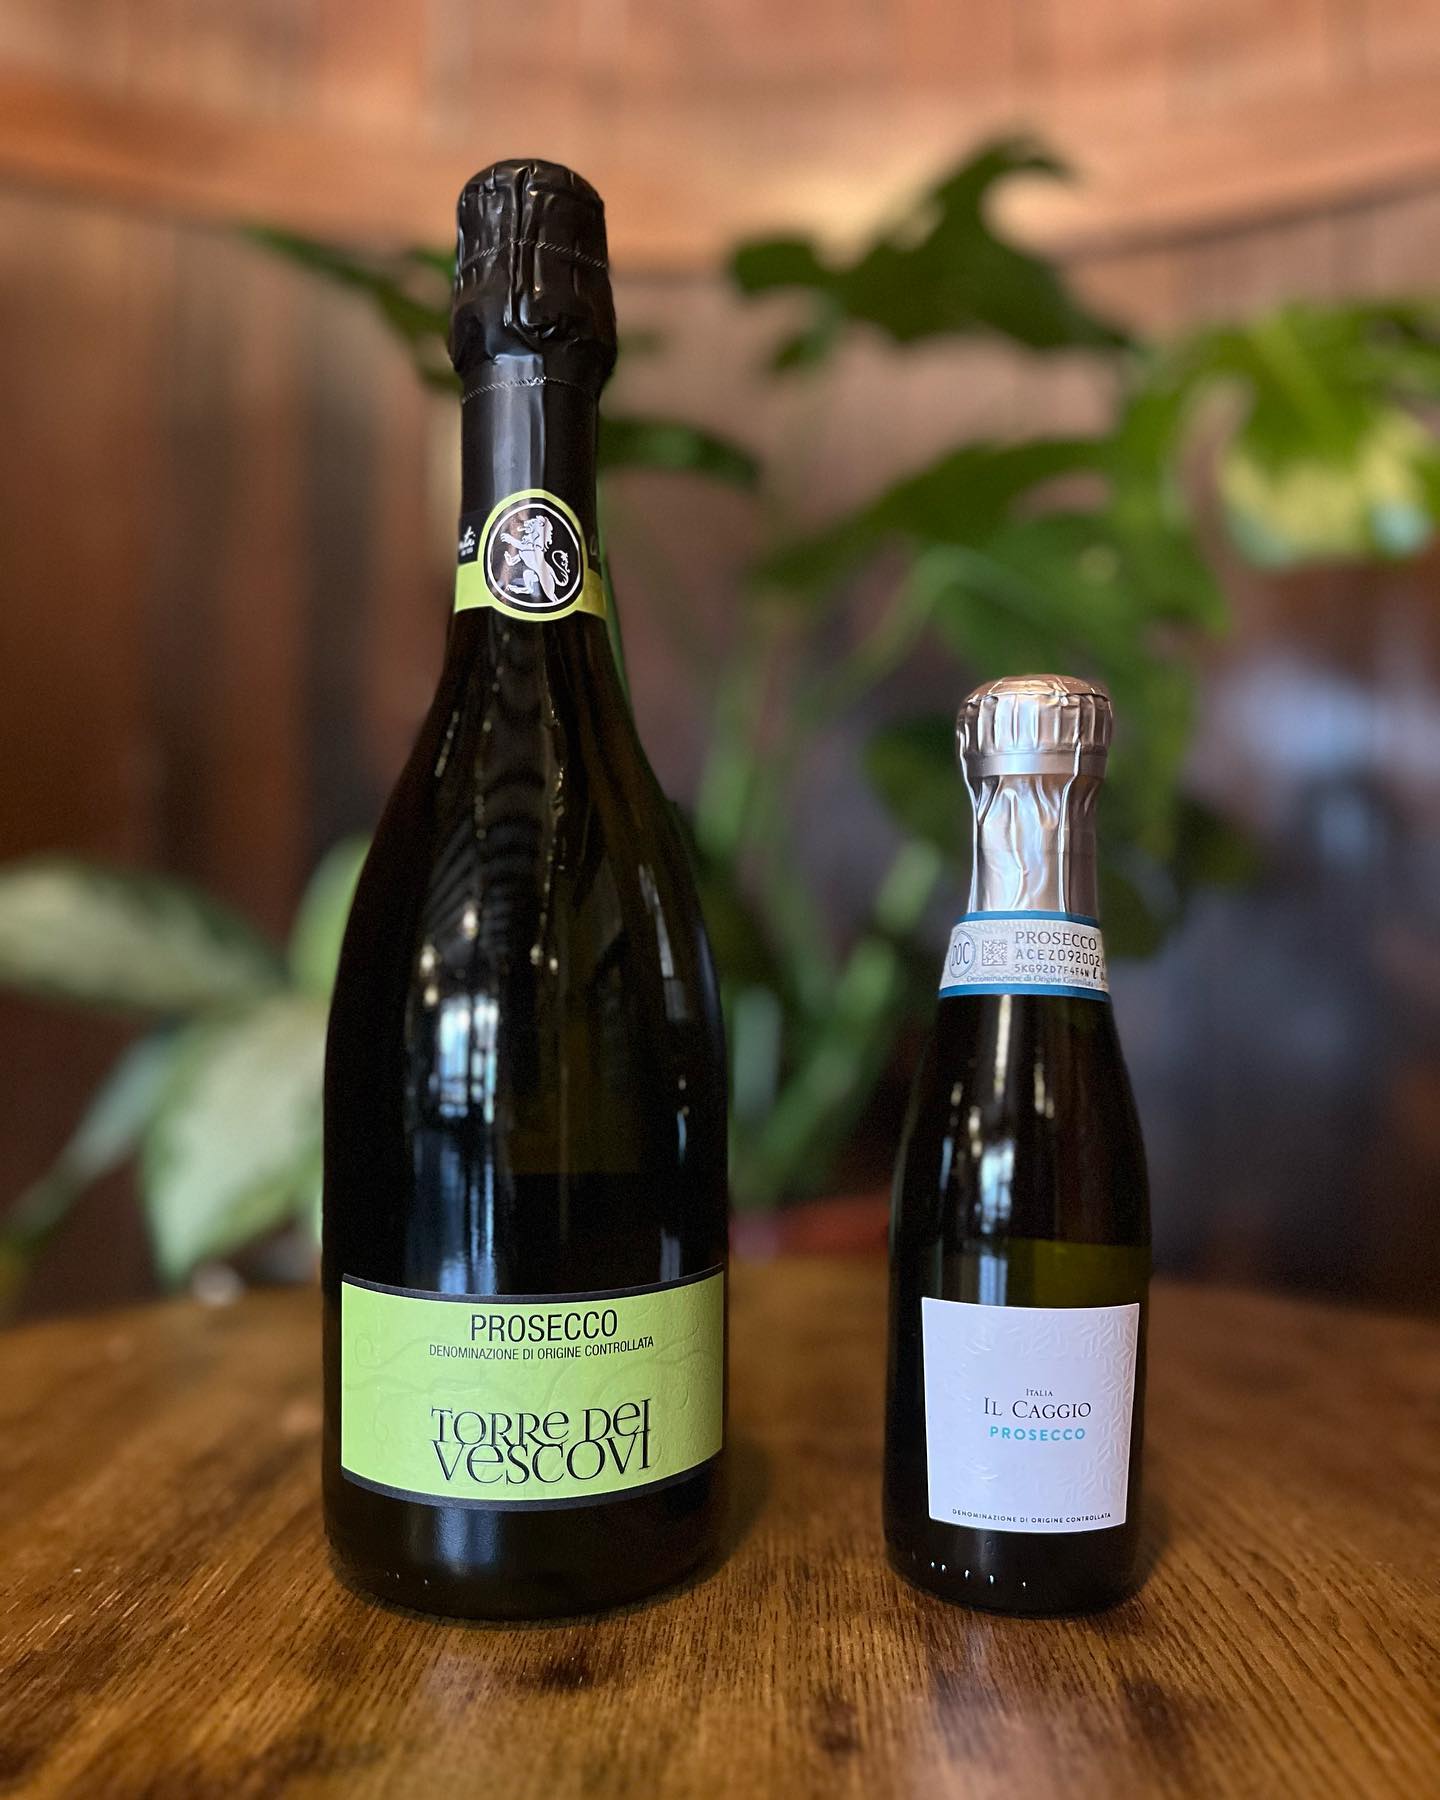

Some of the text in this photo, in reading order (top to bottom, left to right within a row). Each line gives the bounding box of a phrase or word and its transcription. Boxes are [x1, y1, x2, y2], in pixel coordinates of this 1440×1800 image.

[1015, 931, 1097, 950] PROSECCO
[471, 1309, 618, 1342] PROSECCO
[429, 1336, 654, 1360] DENOMINAZIONE DI ORIGINE CONTROLLATA
[1026, 1388, 1053, 1397] ITALIA
[984, 1397, 1091, 1419] IL CAGGIO
[990, 1426, 1085, 1441] PROSECCO
[952, 1509, 1016, 1522] DENOMINAZIONE
[1066, 1513, 1111, 1523] CONTROLLATA
